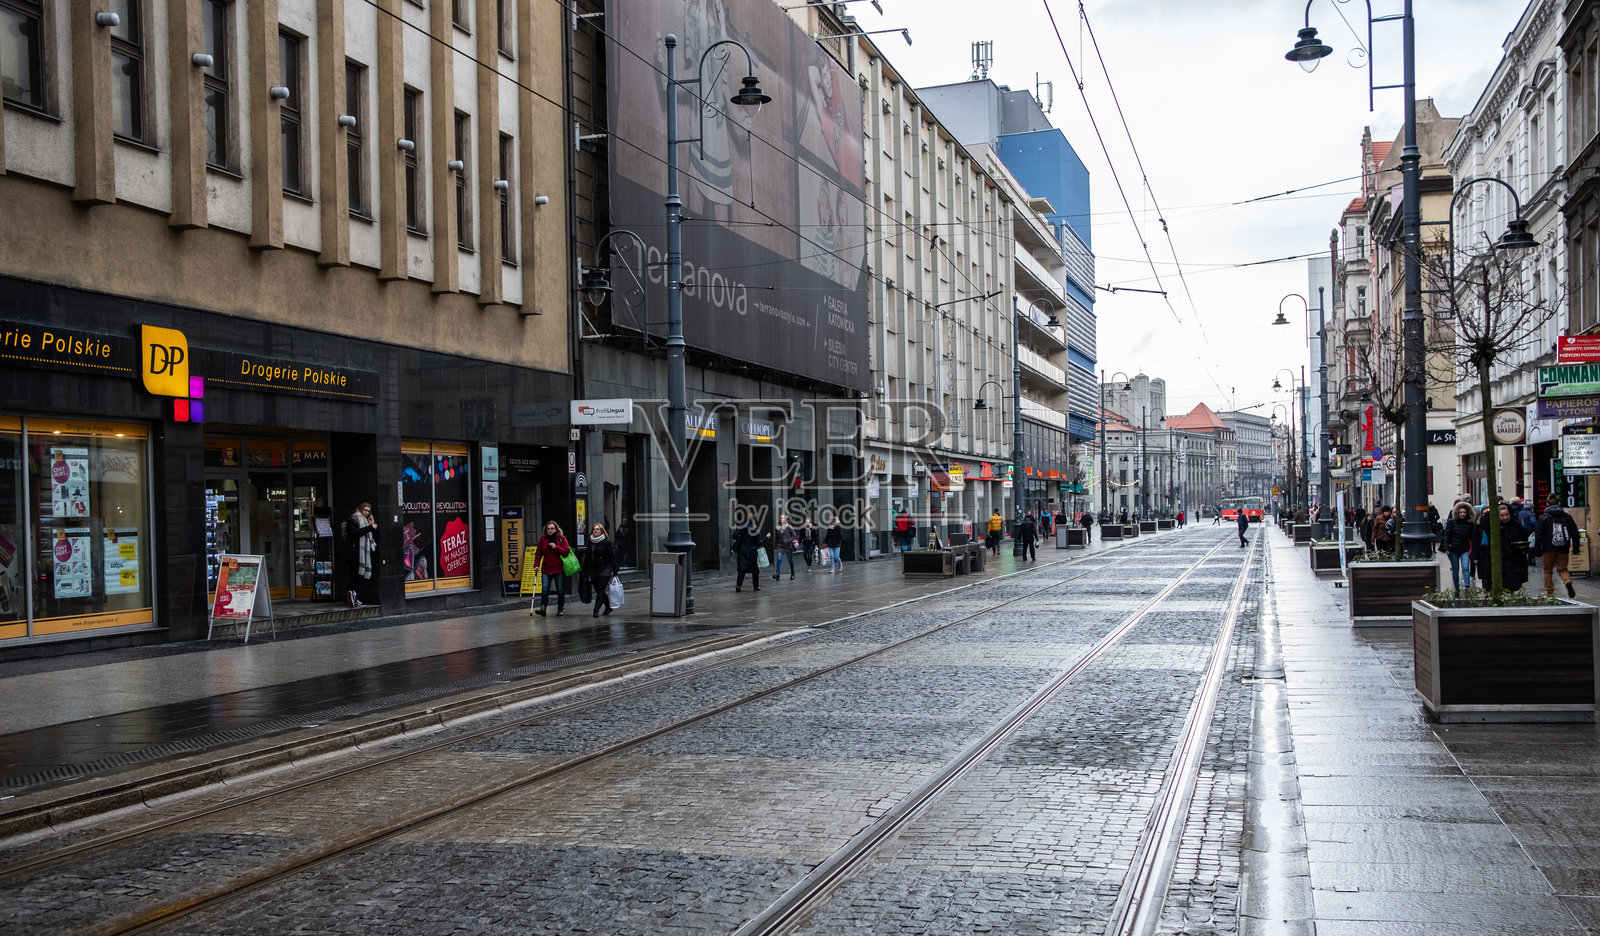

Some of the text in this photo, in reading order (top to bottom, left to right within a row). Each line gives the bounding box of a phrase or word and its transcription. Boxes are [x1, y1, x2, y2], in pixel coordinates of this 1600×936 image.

[828, 296, 848, 316] GALERIA
[828, 311, 855, 334] KATOWICKA
[42, 332, 111, 358] Polskie
[149, 343, 185, 376] DP
[241, 359, 347, 387] Drogerie Polskie
[1540, 365, 1600, 384] COMMAN
[596, 407, 625, 415] ProfiLingua
[1557, 407, 1597, 417] TYTONIE
[66, 423, 91, 432] Drogerie
[1433, 433, 1442, 442] La
[436, 501, 467, 510] REVOLUTION
[1538, 480, 1549, 513] UTLET
[442, 530, 467, 553] TERAZ
[507, 521, 519, 579] TELEFONY
[444, 553, 450, 563] W
[446, 556, 468, 572] OFERCIE!
